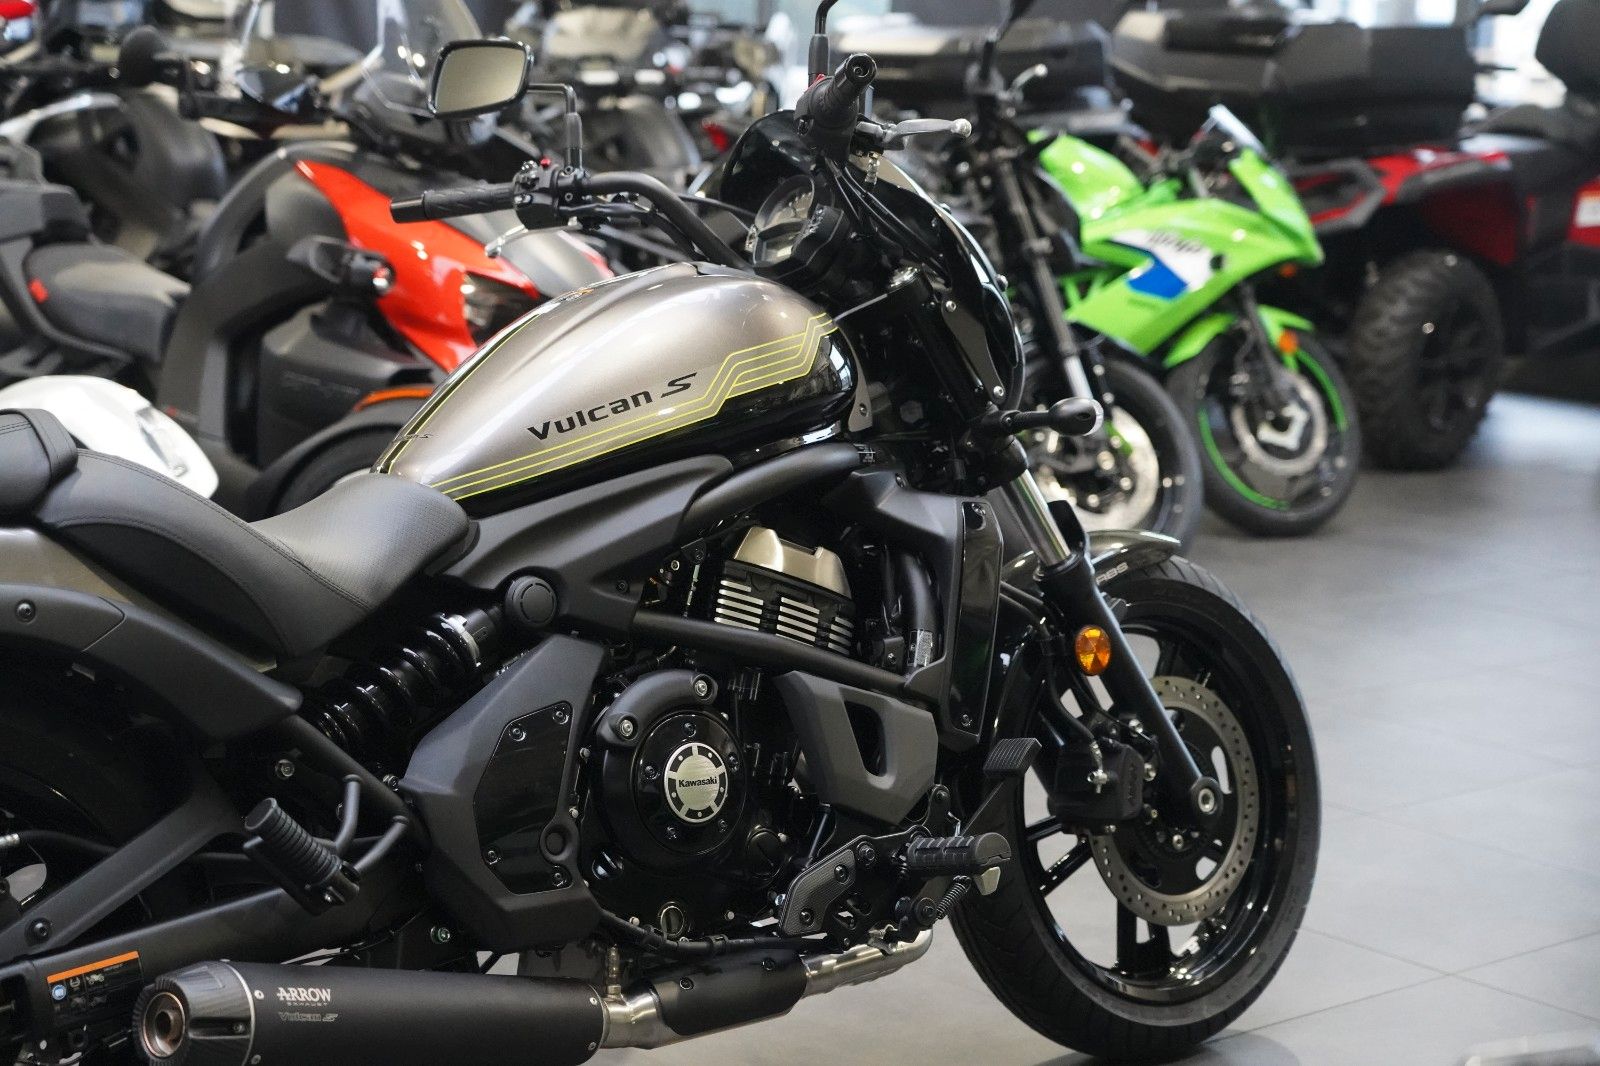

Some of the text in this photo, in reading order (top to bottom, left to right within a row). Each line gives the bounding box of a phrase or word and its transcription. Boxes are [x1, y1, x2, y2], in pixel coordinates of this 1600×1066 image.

[527, 372, 697, 441] Vulcan S
[678, 776, 718, 788] Kawasaki
[276, 986, 331, 1002] ARROW
